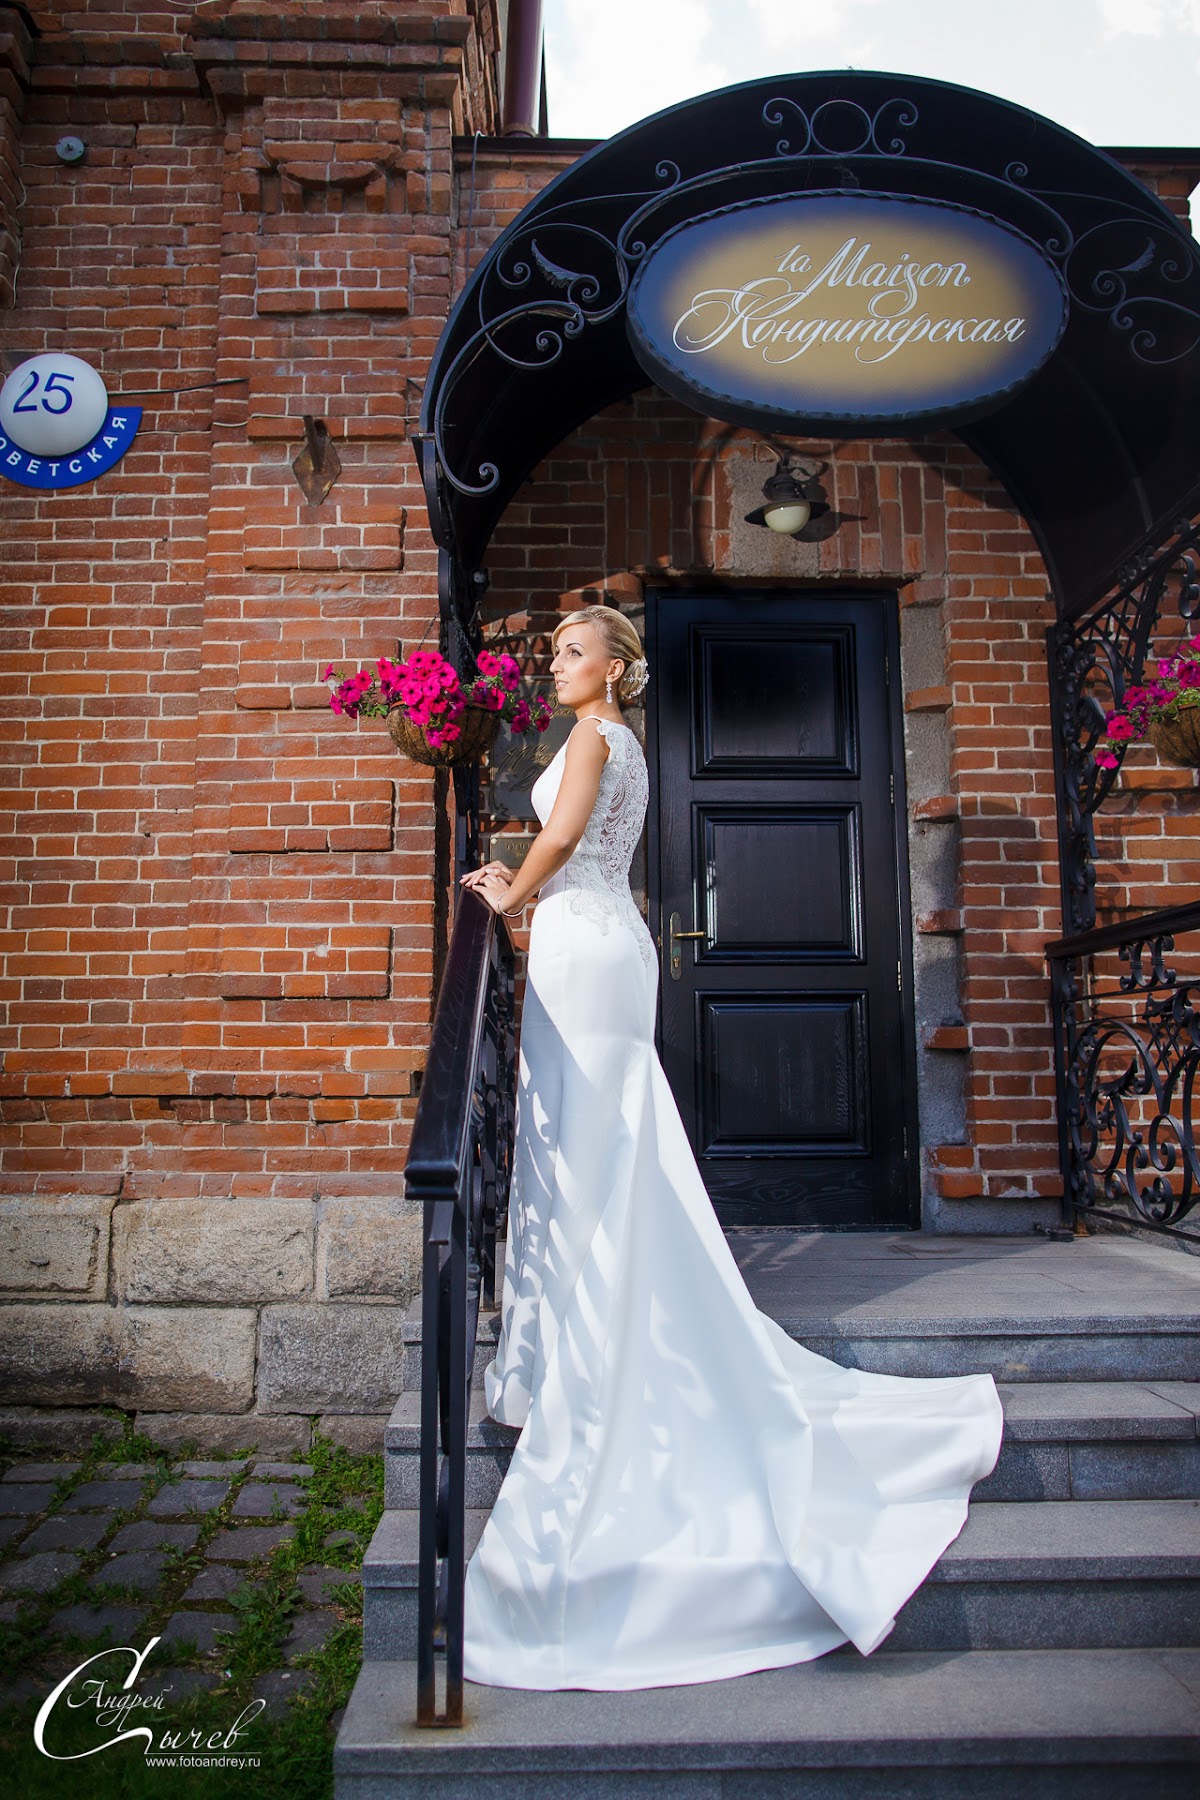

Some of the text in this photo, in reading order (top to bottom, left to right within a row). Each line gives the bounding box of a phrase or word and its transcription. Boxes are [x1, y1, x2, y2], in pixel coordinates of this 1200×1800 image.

[731, 237, 970, 318] Maison
[672, 288, 1026, 364] Кондитерская
[13, 371, 74, 414] 25
